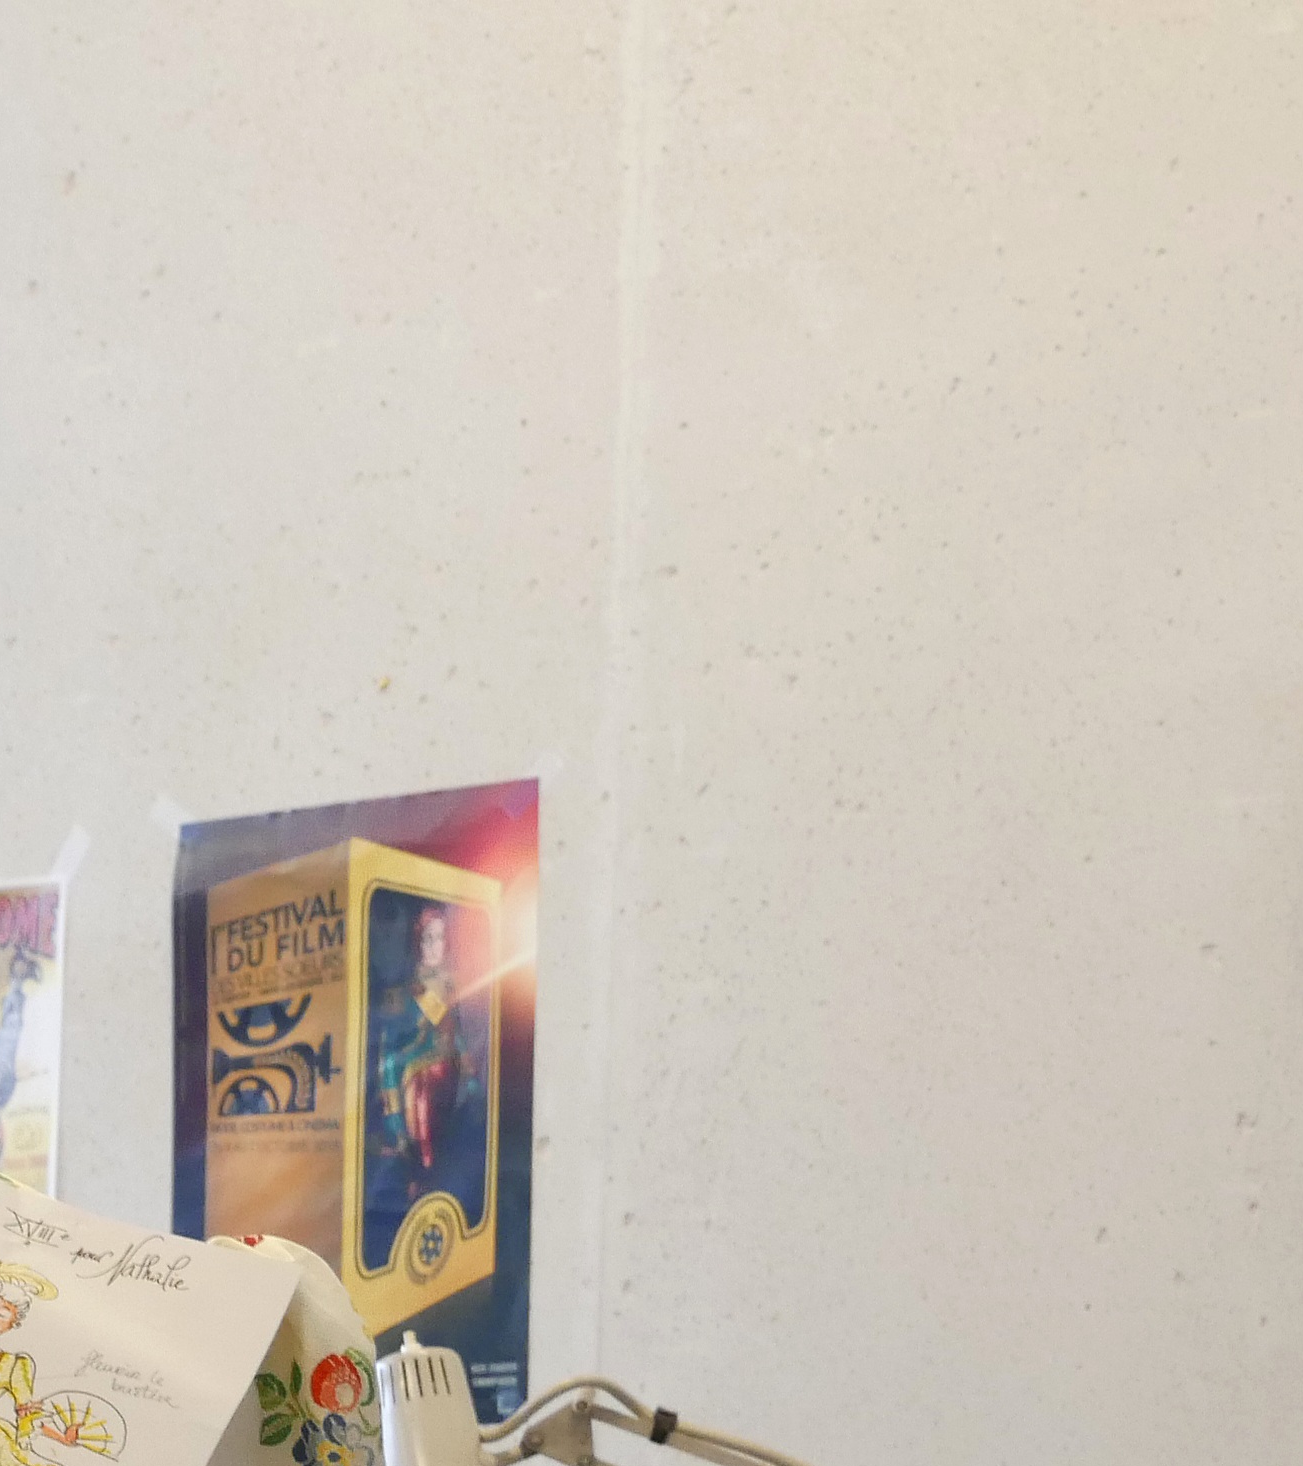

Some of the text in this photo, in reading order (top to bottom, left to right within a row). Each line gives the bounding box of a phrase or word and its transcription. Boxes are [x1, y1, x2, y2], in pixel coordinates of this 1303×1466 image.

[227, 888, 344, 946] FESTIVAL
[227, 918, 346, 972] DU FILM
[70, 1246, 114, 1265] pour
[76, 1234, 192, 1292] Nathalie
